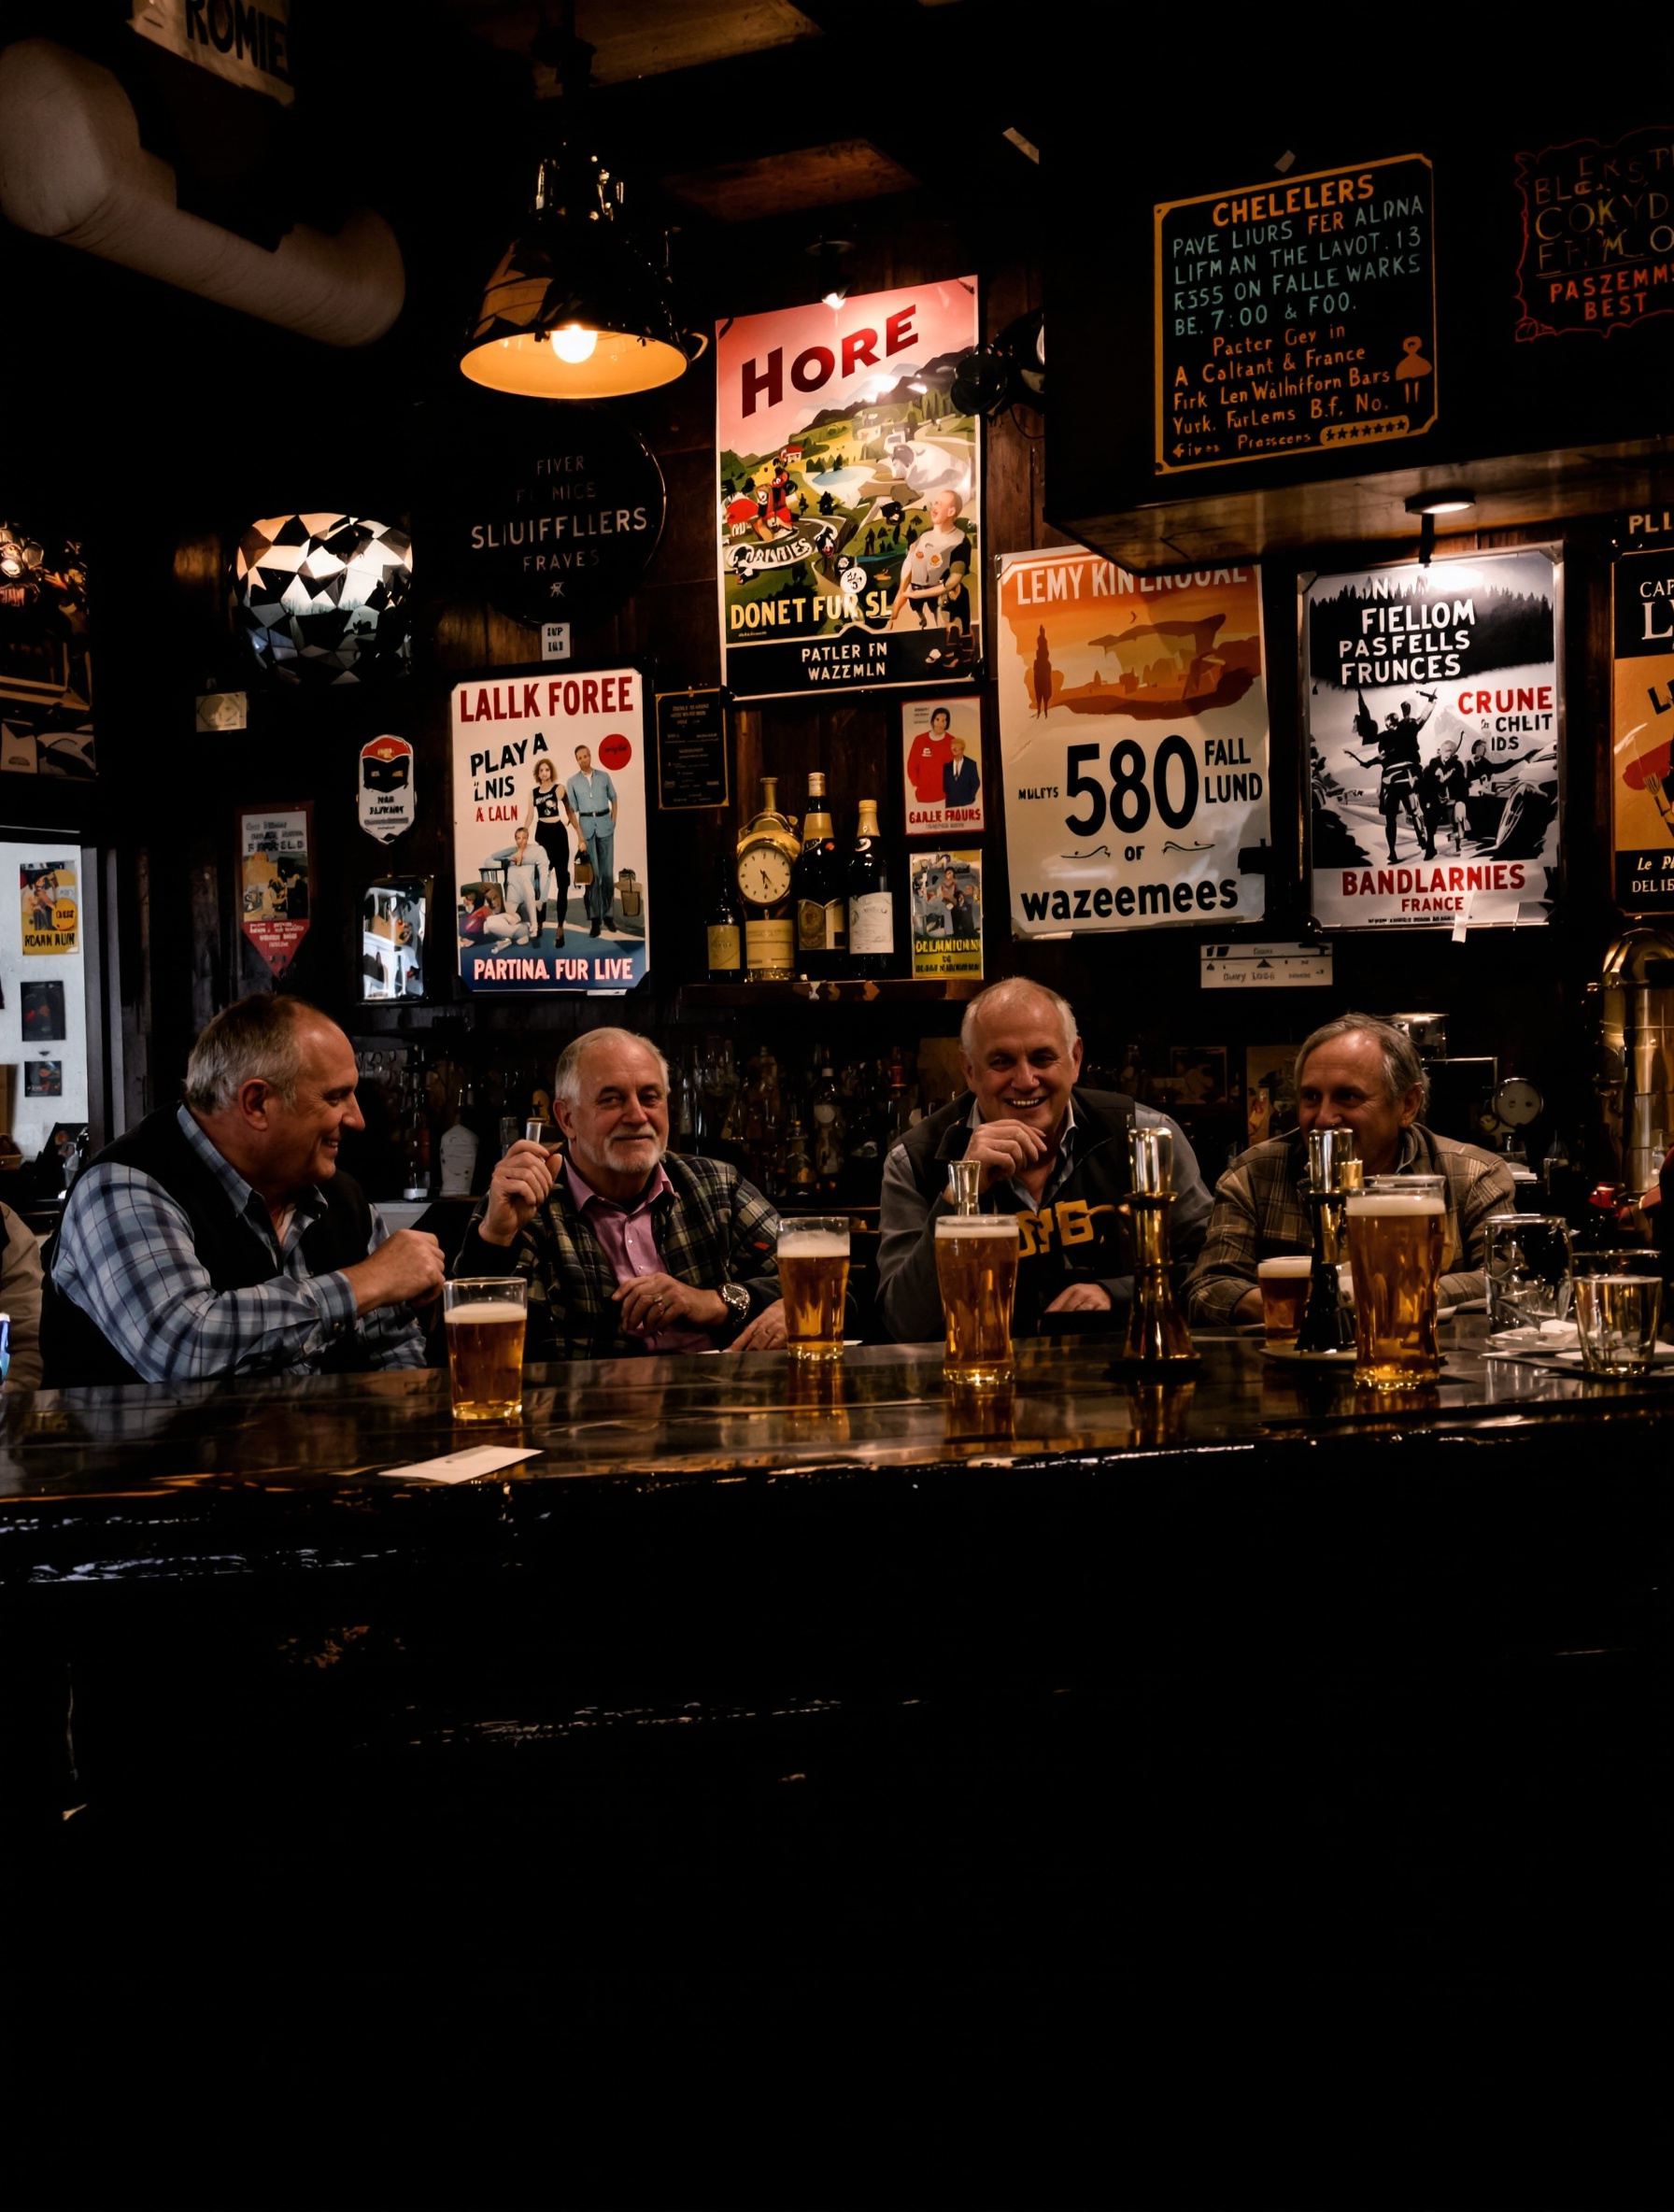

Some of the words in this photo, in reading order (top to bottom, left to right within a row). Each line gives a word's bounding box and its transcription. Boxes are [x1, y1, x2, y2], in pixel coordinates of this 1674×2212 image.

[1213, 174, 1374, 227] CHELELERS
[1173, 234, 1219, 258] PAVE
[1232, 220, 1293, 249] LIURS
[1308, 211, 1344, 234] FER
[1270, 246, 1308, 269] THE
[1234, 279, 1261, 302] ON
[1272, 267, 1341, 295] FALLE
[1346, 253, 1421, 283] WARKS
[1551, 263, 1674, 304] PASZEMM
[1175, 317, 1203, 336] BE.
[1211, 304, 1268, 331] 7:00
[1584, 291, 1647, 321] BEST
[1329, 324, 1345, 340] in
[742, 304, 919, 419] HORE
[1175, 365, 1188, 388] A
[1283, 353, 1297, 372] &
[1306, 347, 1366, 370] France
[1221, 386, 1248, 406] Len
[1349, 366, 1391, 388] Bars
[1016, 563, 1085, 605] LEMY
[731, 598, 806, 630] DONET
[1361, 599, 1476, 634] FIELLOM
[802, 644, 860, 662] PATLER
[1341, 653, 1461, 686] FRUNCES
[461, 683, 540, 722] LALLK
[548, 675, 633, 716] FOREE
[1457, 686, 1553, 716] CRUNE
[1065, 734, 1199, 836] 580
[1204, 739, 1251, 766] FALL
[1205, 773, 1263, 803] LUND
[1342, 864, 1526, 896] BANDLARNIES
[1637, 857, 1653, 871] Le
[1021, 877, 1239, 922] wazeemees
[1401, 897, 1465, 913] FRANCE
[555, 958, 589, 981] FUR
[594, 957, 633, 980] LIVE
